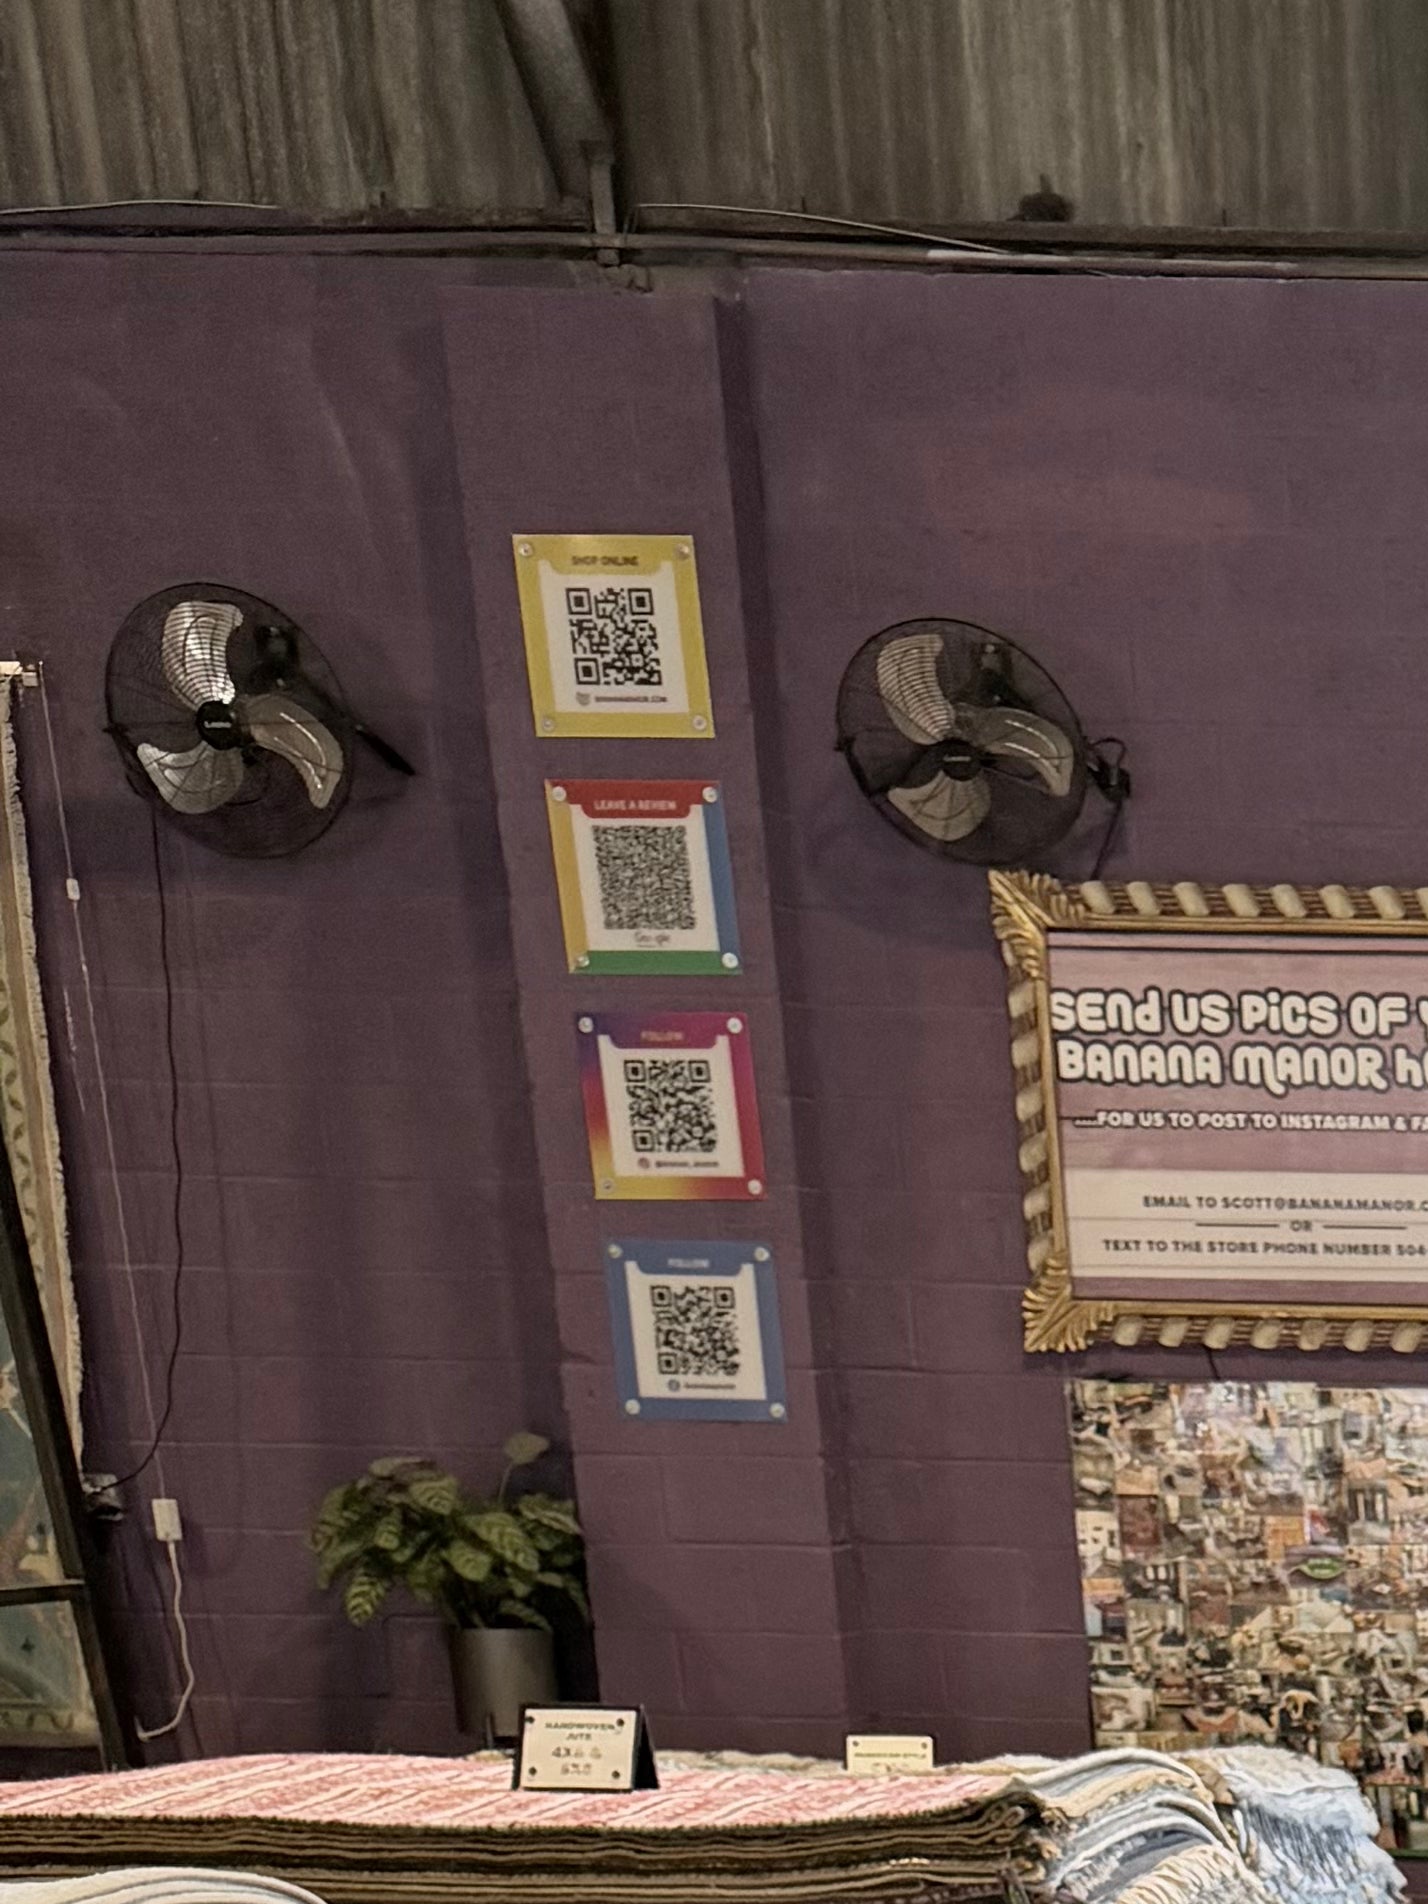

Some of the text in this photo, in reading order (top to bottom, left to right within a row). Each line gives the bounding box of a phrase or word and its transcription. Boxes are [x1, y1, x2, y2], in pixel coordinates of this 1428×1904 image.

[601, 556, 639, 567] ONLINE
[1171, 993, 1235, 1034] US
[1350, 995, 1409, 1037] OF
[1139, 1112, 1165, 1129] US
[1169, 1112, 1194, 1130] TO
[1198, 1112, 1246, 1131] POST
[1250, 1113, 1278, 1131] TO
[1281, 1113, 1391, 1132] INSTAGRAM
[1394, 1114, 1408, 1132] &
[1142, 1195, 1191, 1209] EMAIL
[1196, 1196, 1218, 1209] TO
[1289, 1220, 1313, 1232] OR
[1103, 1239, 1141, 1252] TEXT
[1147, 1240, 1169, 1253] TO
[1172, 1240, 1202, 1253] THE
[1206, 1240, 1258, 1254] STORE
[1262, 1241, 1318, 1255] PHONE
[1322, 1242, 1393, 1257] NUMBER
